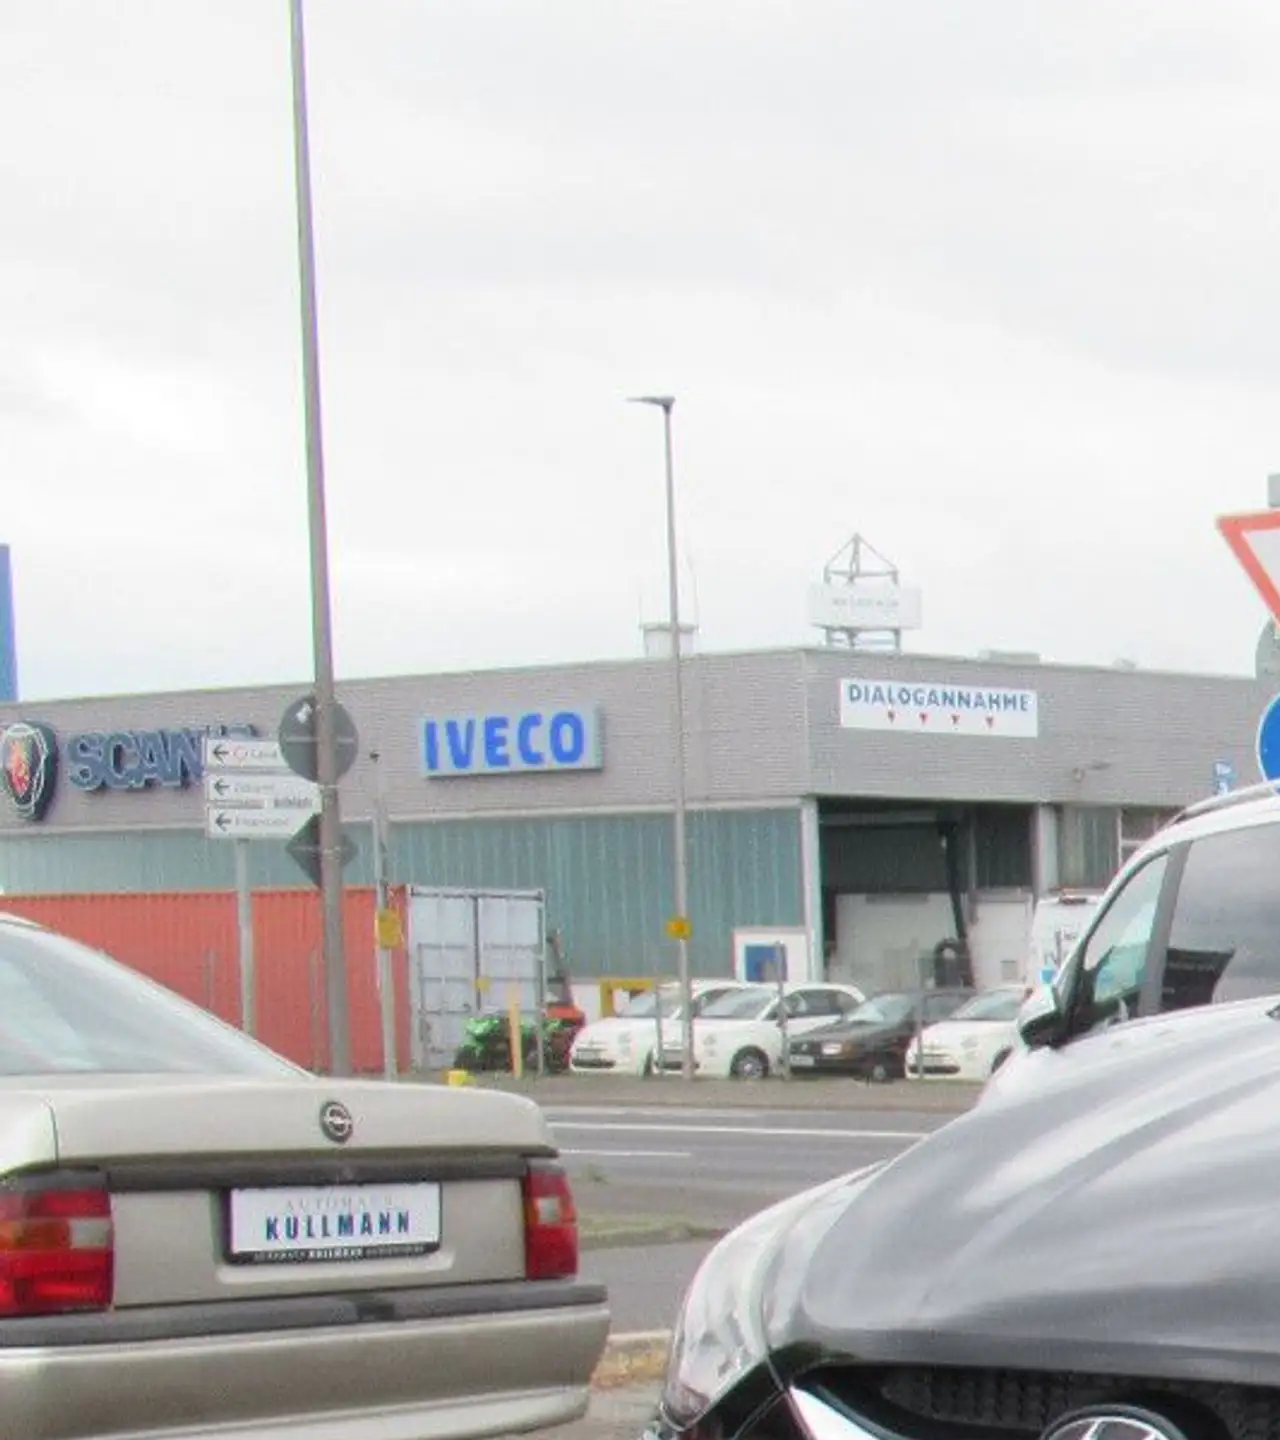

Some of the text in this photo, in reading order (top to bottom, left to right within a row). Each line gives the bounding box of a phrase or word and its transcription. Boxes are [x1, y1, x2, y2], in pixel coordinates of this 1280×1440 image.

[848, 683, 1029, 713] DIALOGANNAHME
[67, 724, 258, 791] SCAN
[424, 711, 585, 771] IVECO
[265, 1211, 410, 1241] KULLMANN
